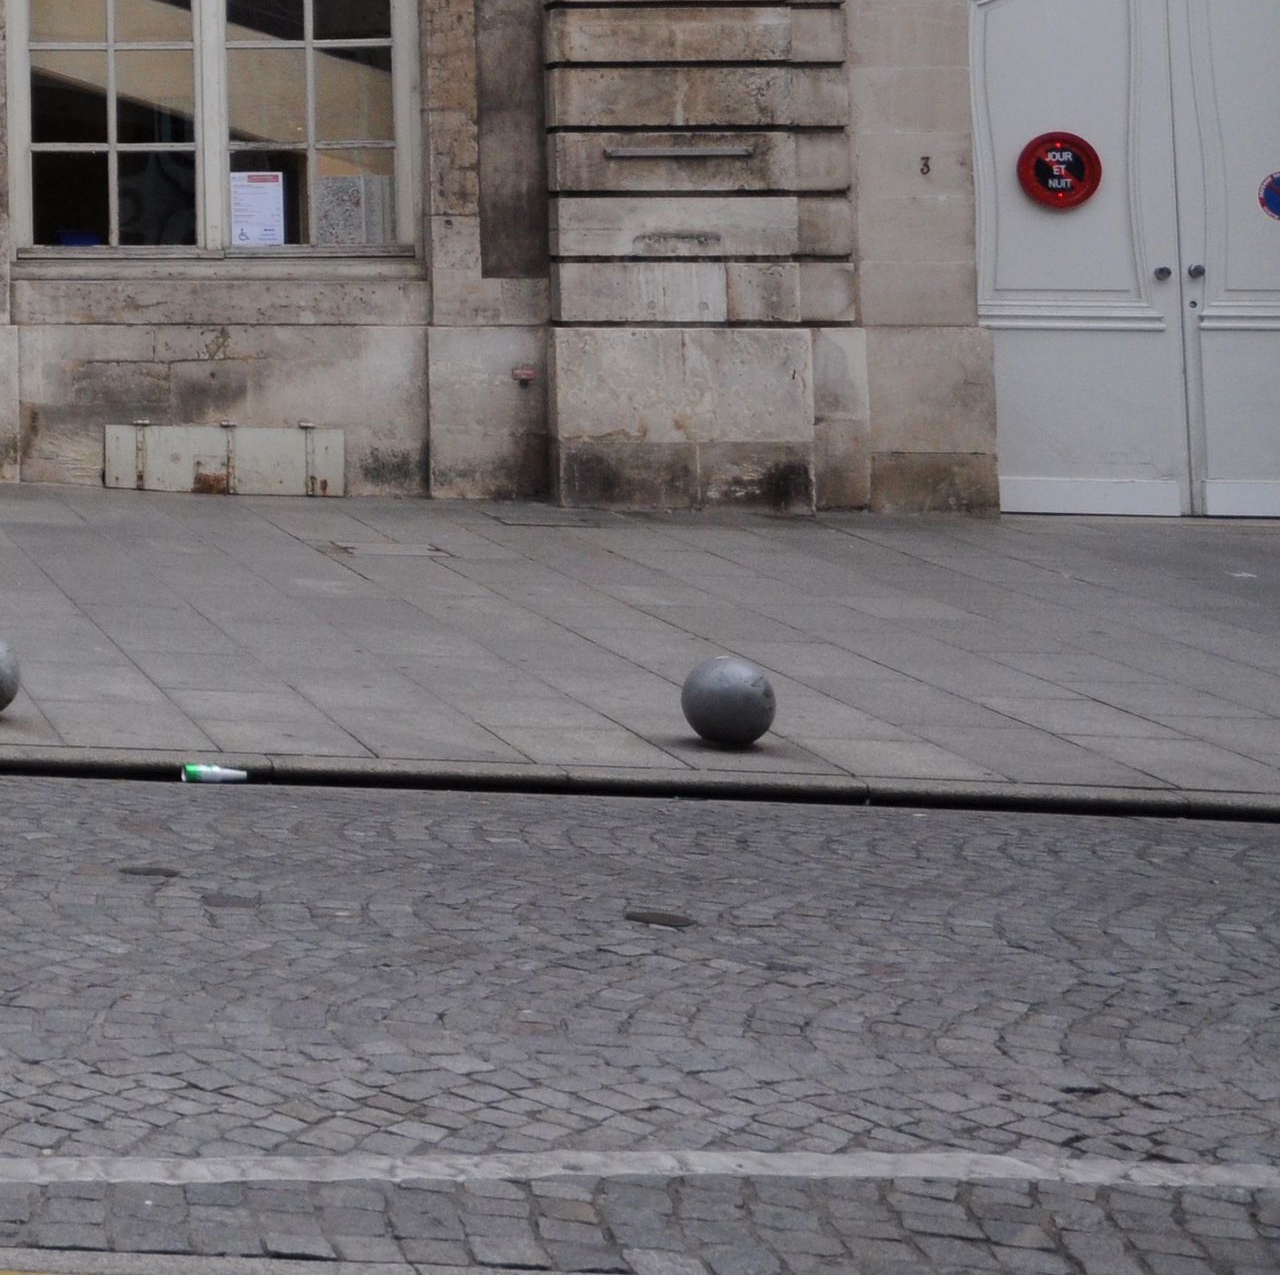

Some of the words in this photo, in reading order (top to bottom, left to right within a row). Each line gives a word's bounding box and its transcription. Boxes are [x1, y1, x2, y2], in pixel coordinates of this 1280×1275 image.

[1045, 151, 1073, 161] JOUR
[920, 156, 930, 175] 3
[1053, 165, 1066, 175] ET
[1048, 178, 1072, 188] NUIT
